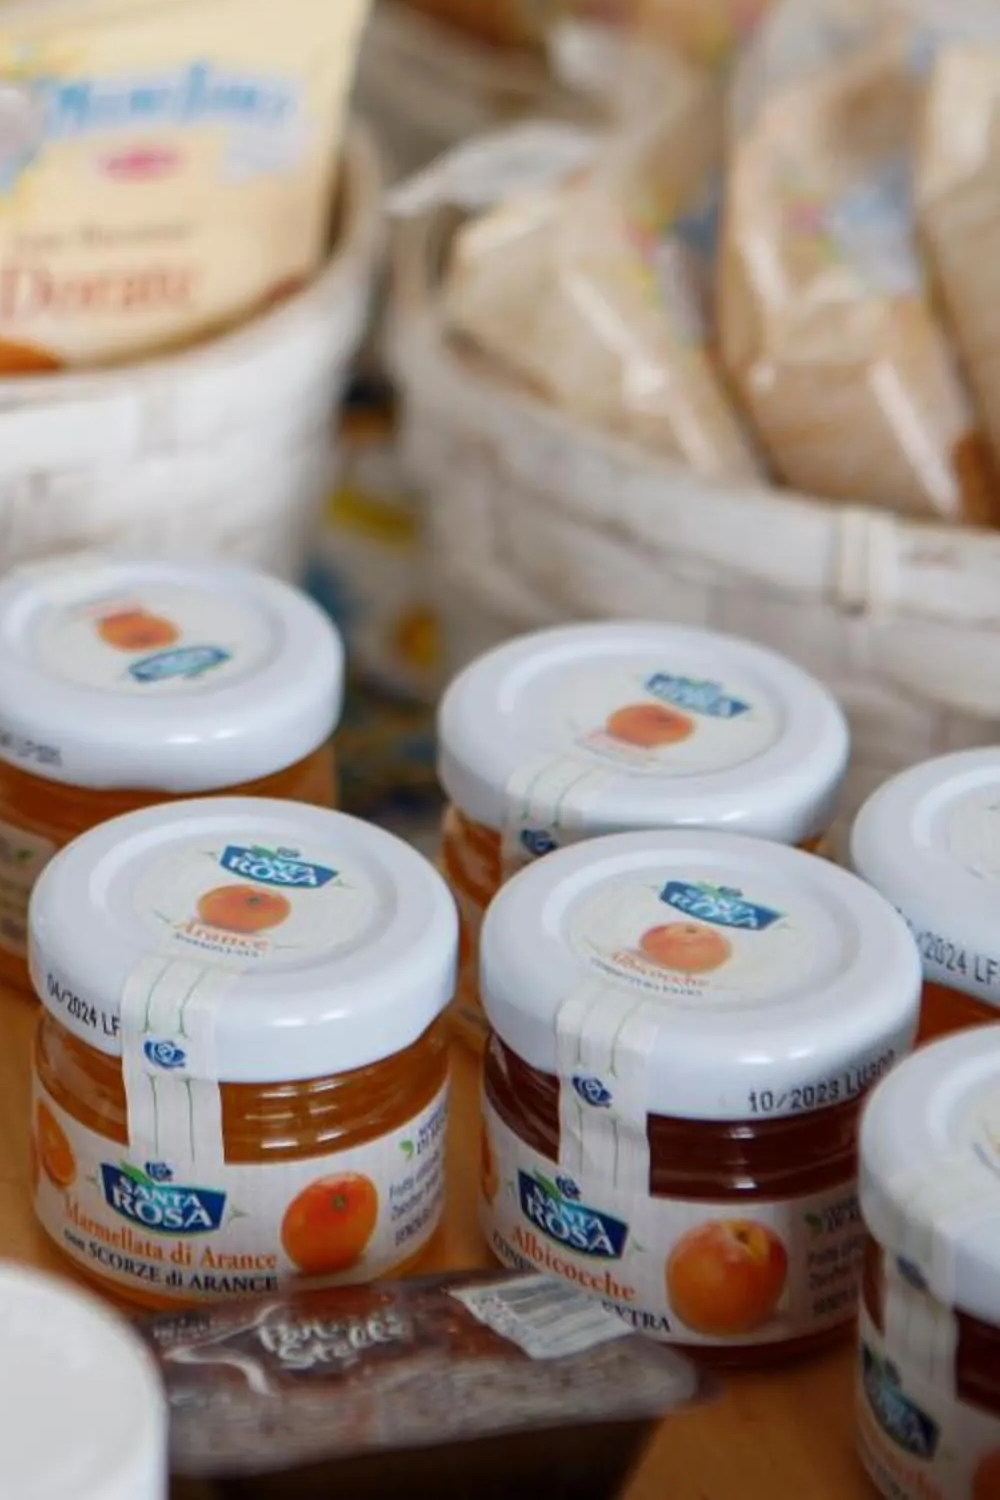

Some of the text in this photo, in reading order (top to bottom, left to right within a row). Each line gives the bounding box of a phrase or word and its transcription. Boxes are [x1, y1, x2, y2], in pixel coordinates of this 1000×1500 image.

[228, 855, 318, 886] ROSA
[748, 1079, 840, 1113] 10/2023
[112, 1187, 214, 1228] ROSA
[118, 1174, 204, 1209] SANTA
[533, 1184, 610, 1235] SANTA
[526, 1192, 616, 1255] ROSA
[88, 1239, 163, 1284] SCORZE
[165, 1269, 184, 1288] di
[189, 1274, 279, 1293] ARANCE
[170, 1240, 193, 1267] di
[202, 1245, 278, 1271] Arance
[512, 1224, 636, 1302] Albicocche
